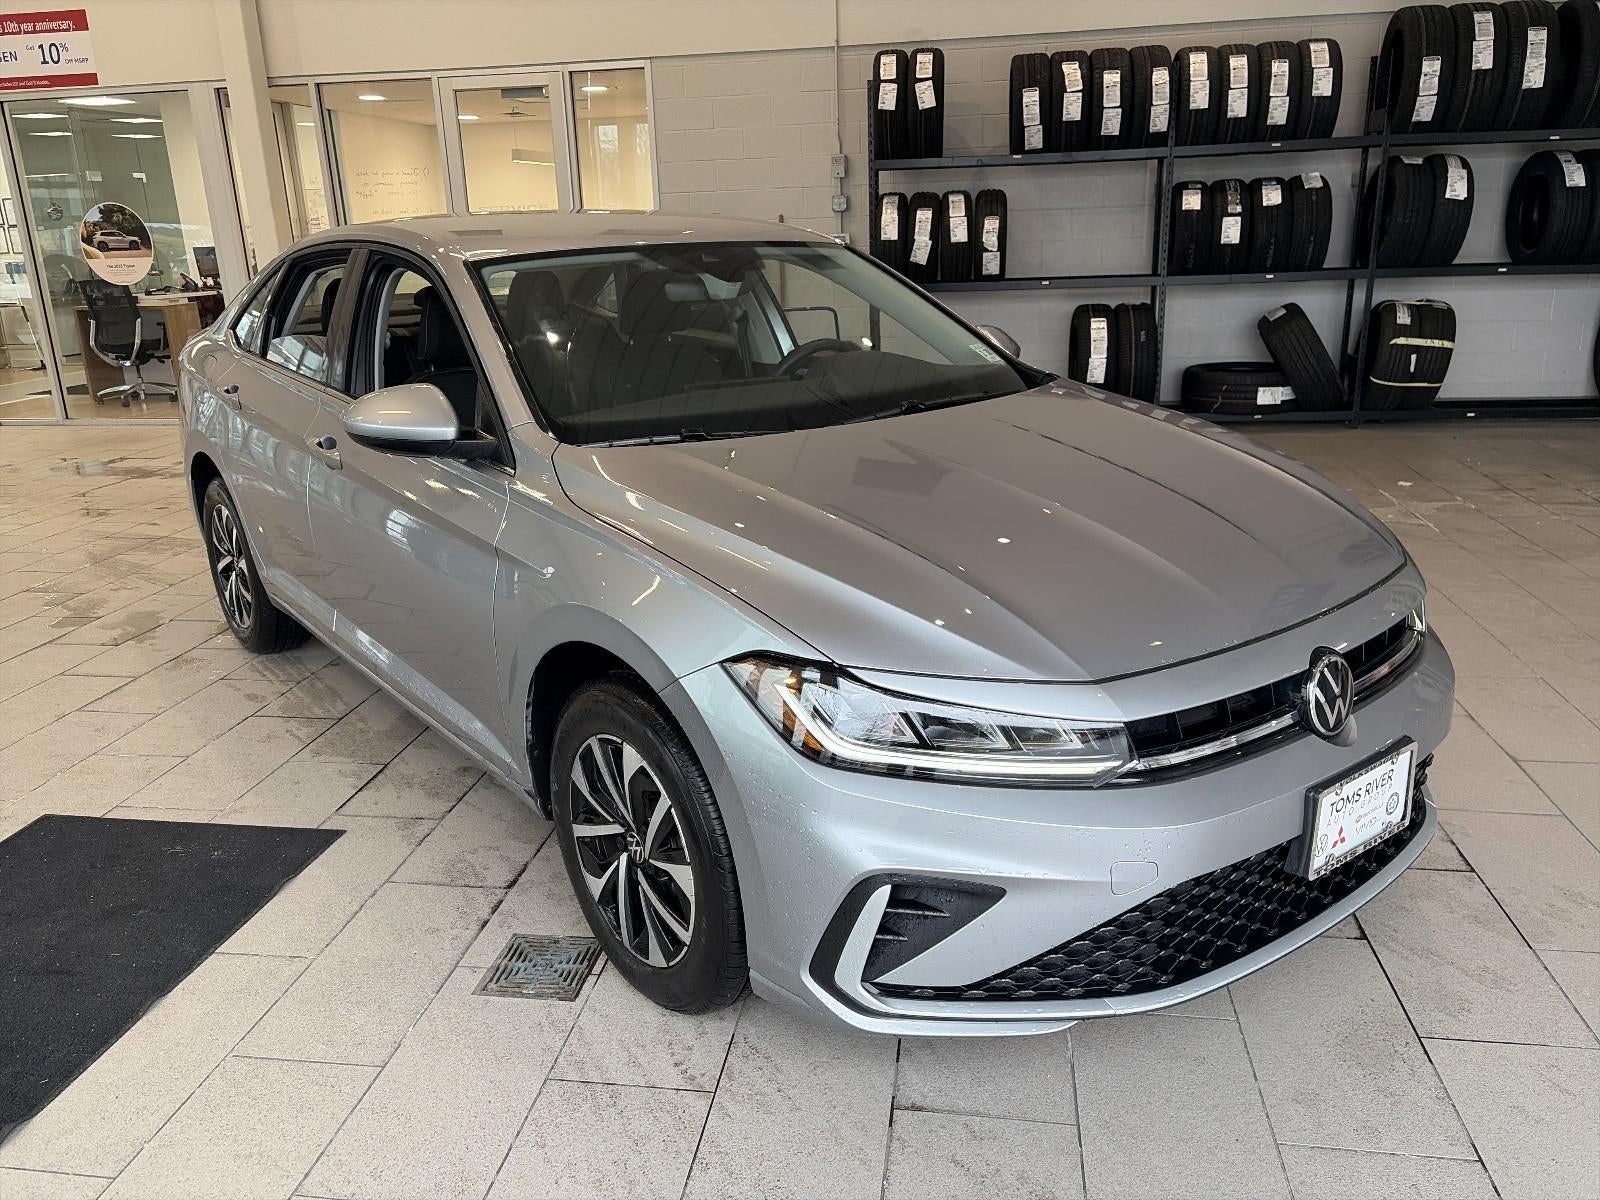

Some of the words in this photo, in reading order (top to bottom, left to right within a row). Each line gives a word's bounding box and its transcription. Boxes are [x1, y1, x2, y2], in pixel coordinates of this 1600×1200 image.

[4, 20, 20, 33] 10th
[20, 22, 34, 35] year
[35, 19, 76, 32] anniversary.
[0, 50, 18, 63] EN
[1327, 806, 1355, 827] AUTO
[1361, 783, 1393, 809] GROUP
[1330, 787, 1362, 816] TOMS
[1364, 768, 1394, 799] RIVER
[1313, 849, 1358, 877] TOMS
[1362, 821, 1406, 851] RIVER
